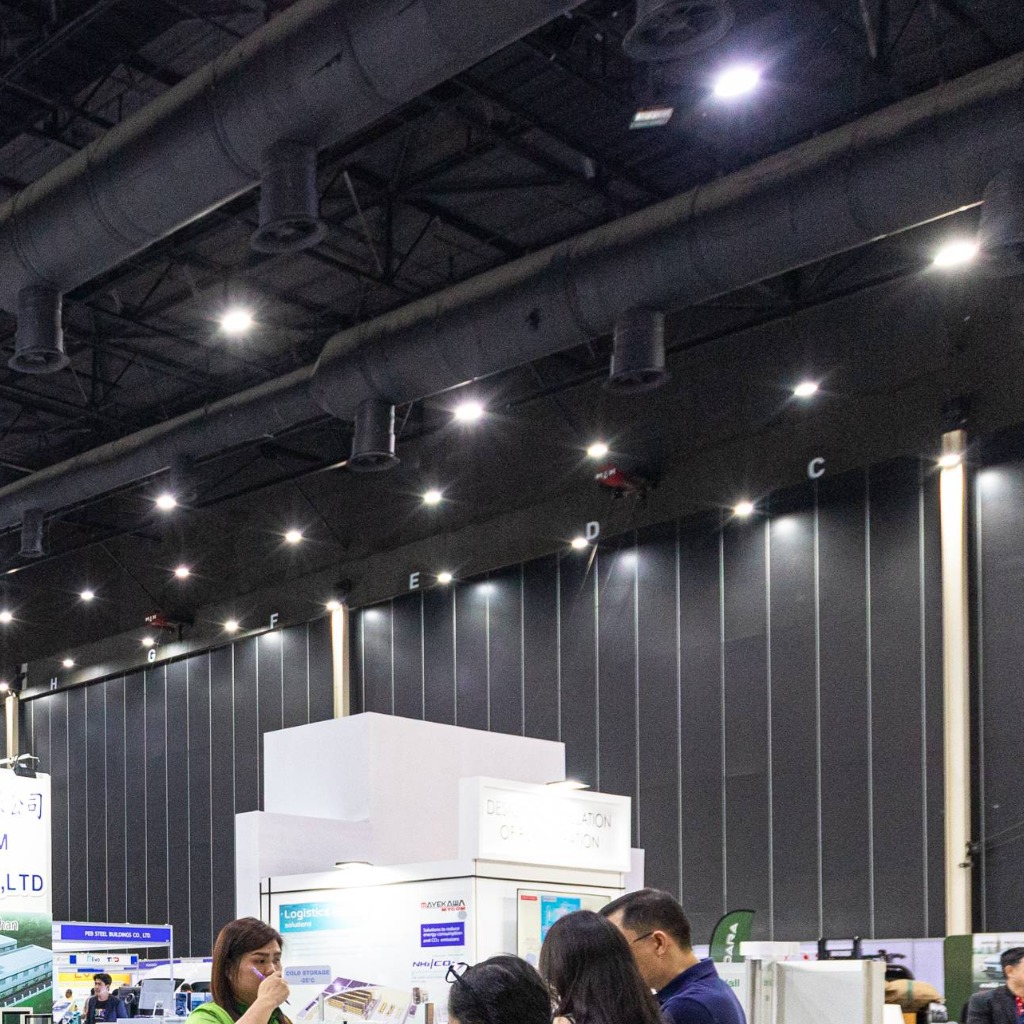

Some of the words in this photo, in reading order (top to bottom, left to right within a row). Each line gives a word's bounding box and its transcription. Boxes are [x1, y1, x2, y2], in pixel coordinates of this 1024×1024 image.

[807, 457, 826, 479] C
[586, 520, 600, 540] D
[409, 571, 420, 589] E
[270, 612, 279, 629] F
[147, 648, 156, 662] G
[50, 676, 58, 690] H
